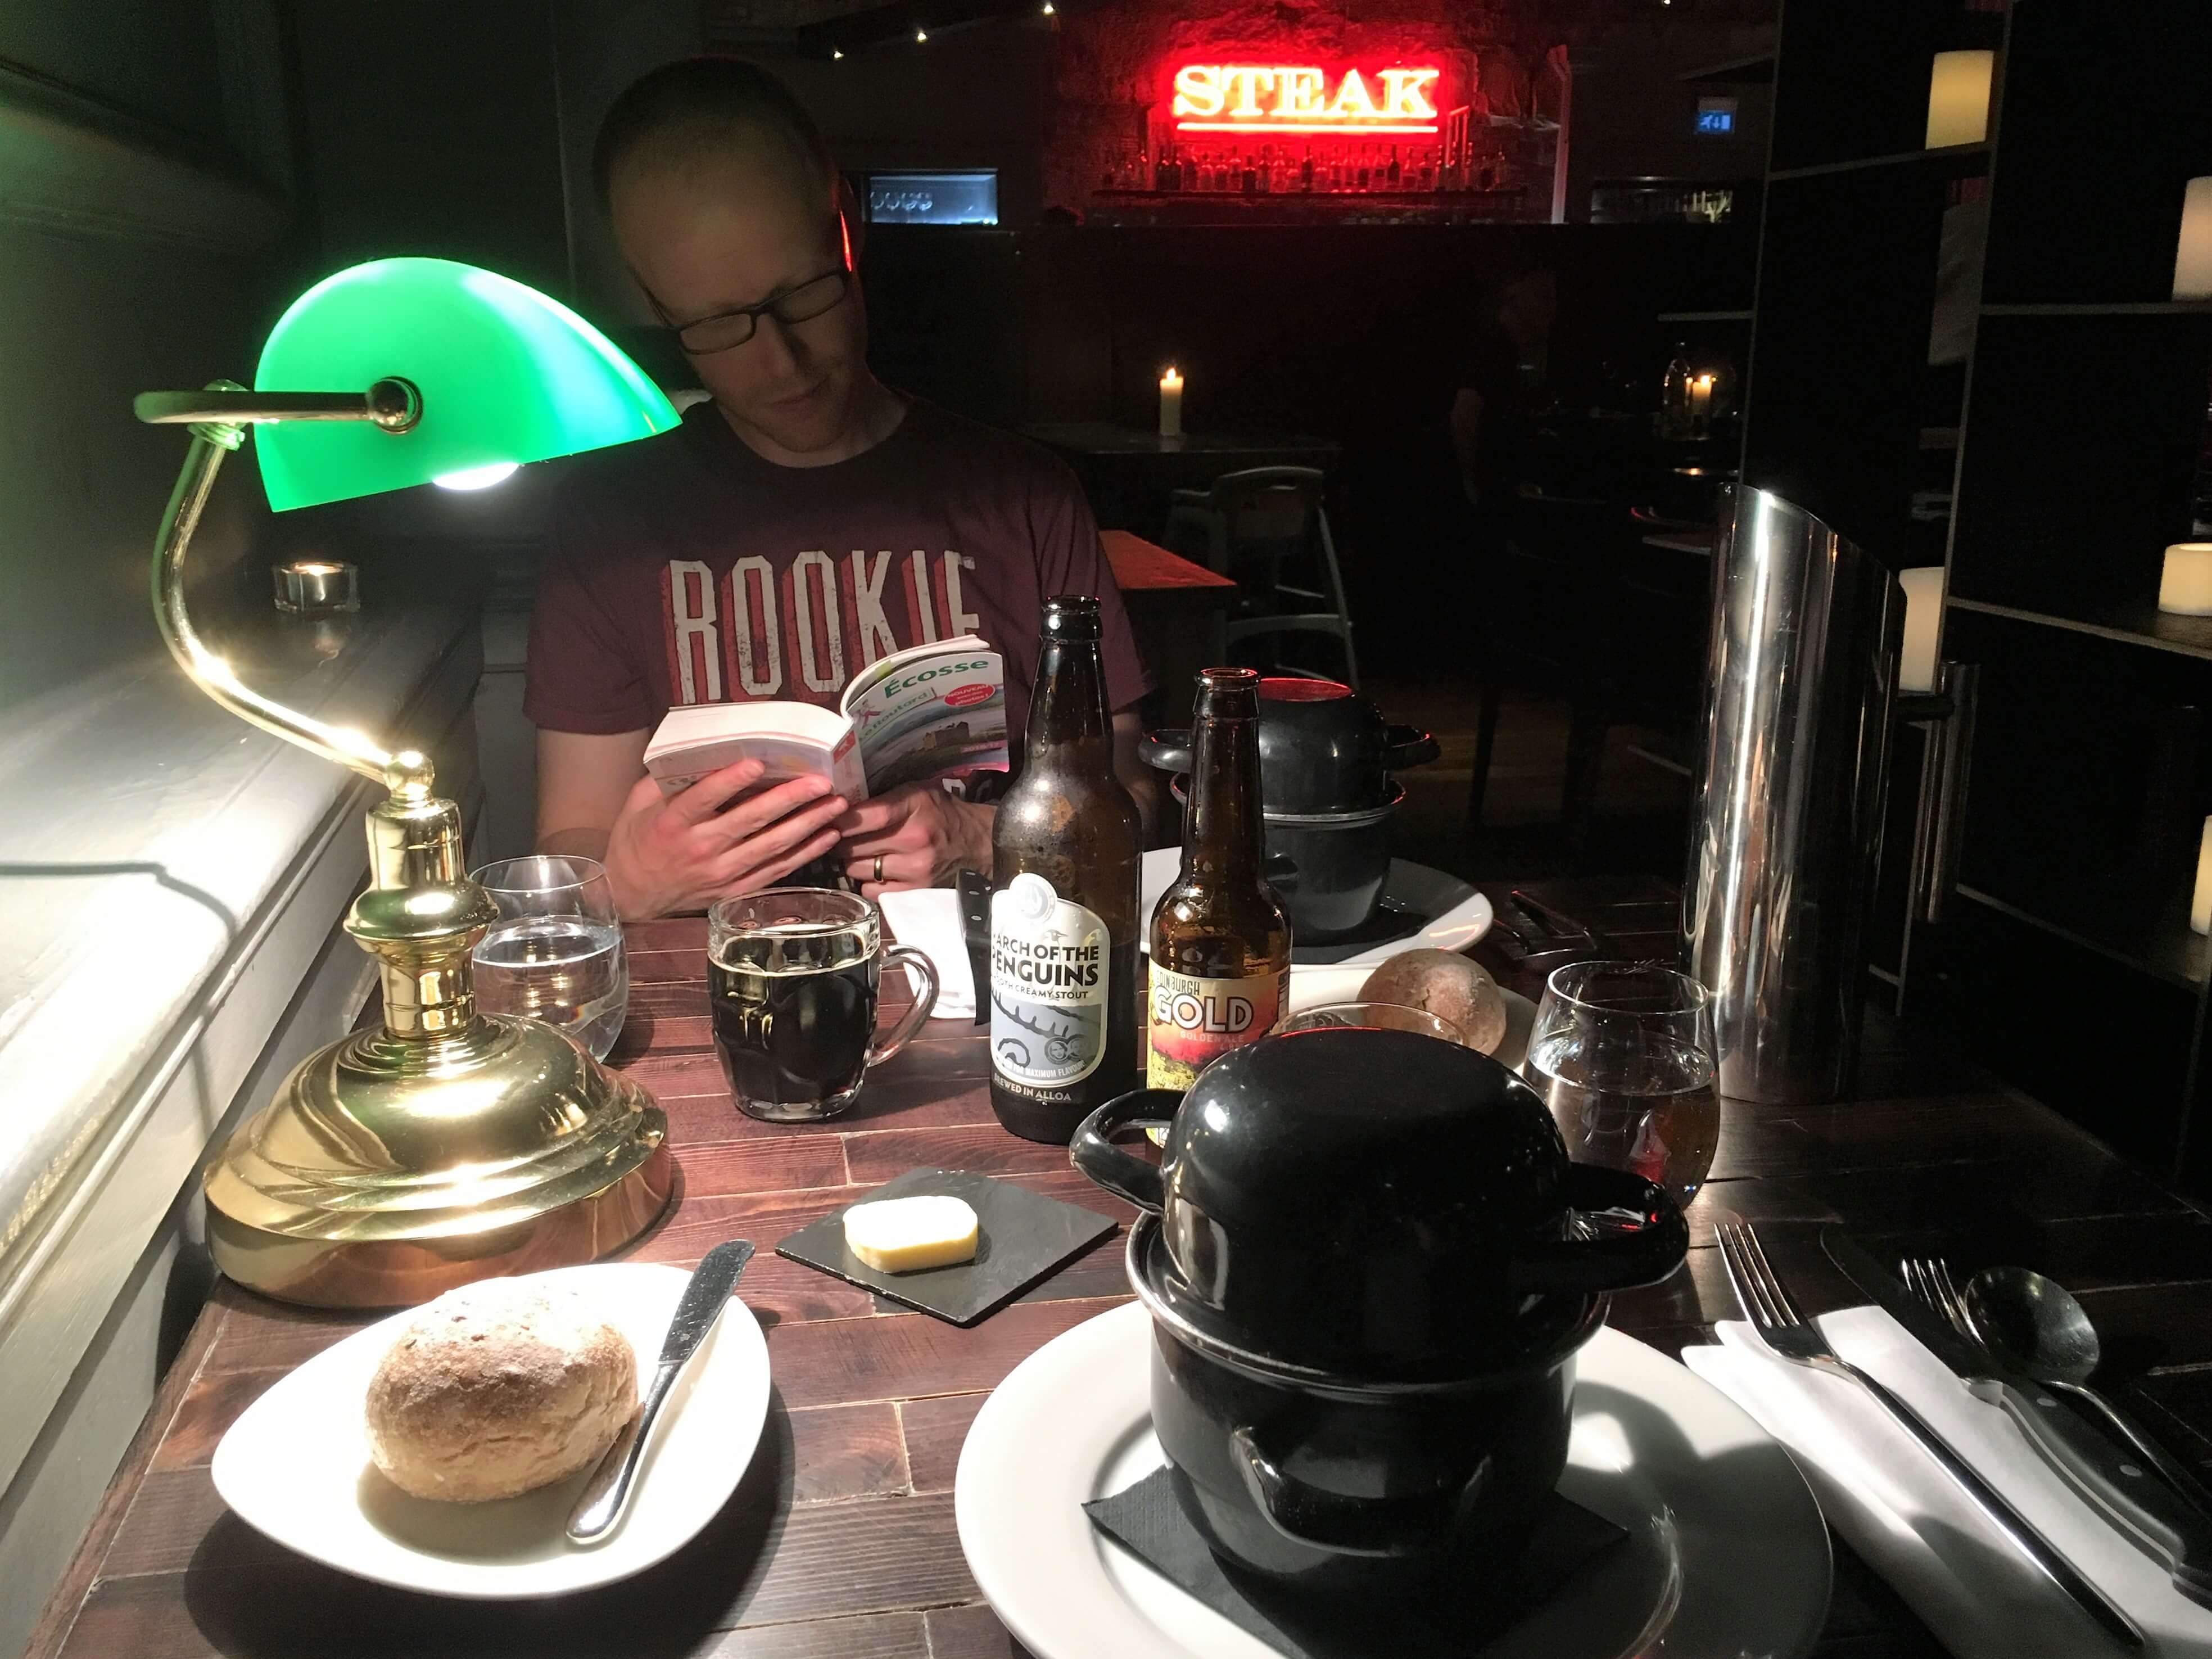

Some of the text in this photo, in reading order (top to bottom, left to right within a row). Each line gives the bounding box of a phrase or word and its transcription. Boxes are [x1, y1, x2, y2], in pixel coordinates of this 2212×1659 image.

[1174, 65, 1440, 118] STEAK
[884, 660, 989, 699] Écosse
[993, 932, 1100, 961] ARCH OF THE
[1015, 984, 1054, 998] CREAMY
[1154, 985, 1255, 1033] GOLD
[1180, 1030, 1245, 1043] GOLDEN ALE
[994, 1072, 1071, 1101] BREWED IN ALLOA
[1025, 1068, 1057, 1078] MAXIMUM
